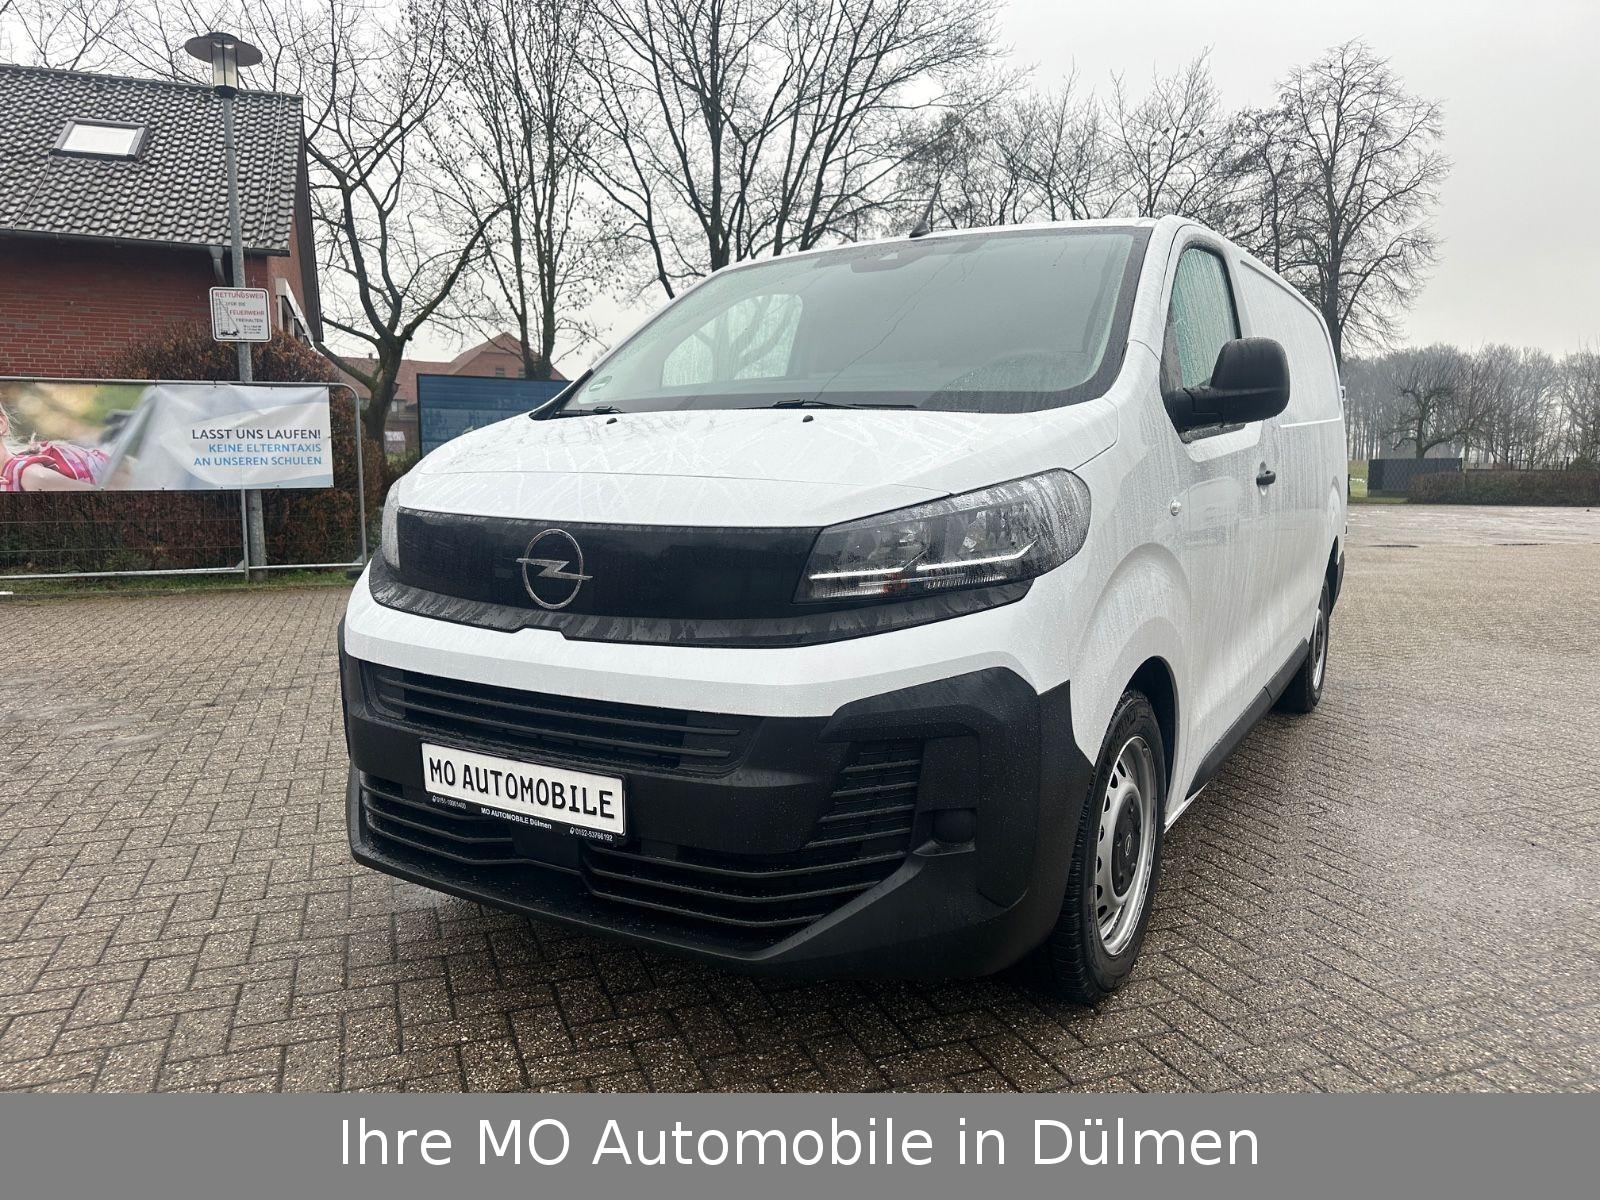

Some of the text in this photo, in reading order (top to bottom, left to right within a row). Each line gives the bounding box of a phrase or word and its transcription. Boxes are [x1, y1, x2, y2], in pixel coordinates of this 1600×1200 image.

[214, 291, 264, 299] RETTUNGSWEG
[192, 429, 321, 439] LASST UNS LAUFEN!
[208, 443, 322, 453] KEINE ELTERNTAXIS
[193, 456, 322, 466] AN UNSEREN SCHULEN
[429, 757, 615, 819] MO AUTOMOBILE
[480, 807, 552, 829] MO AUTOMOBILE Dülmen
